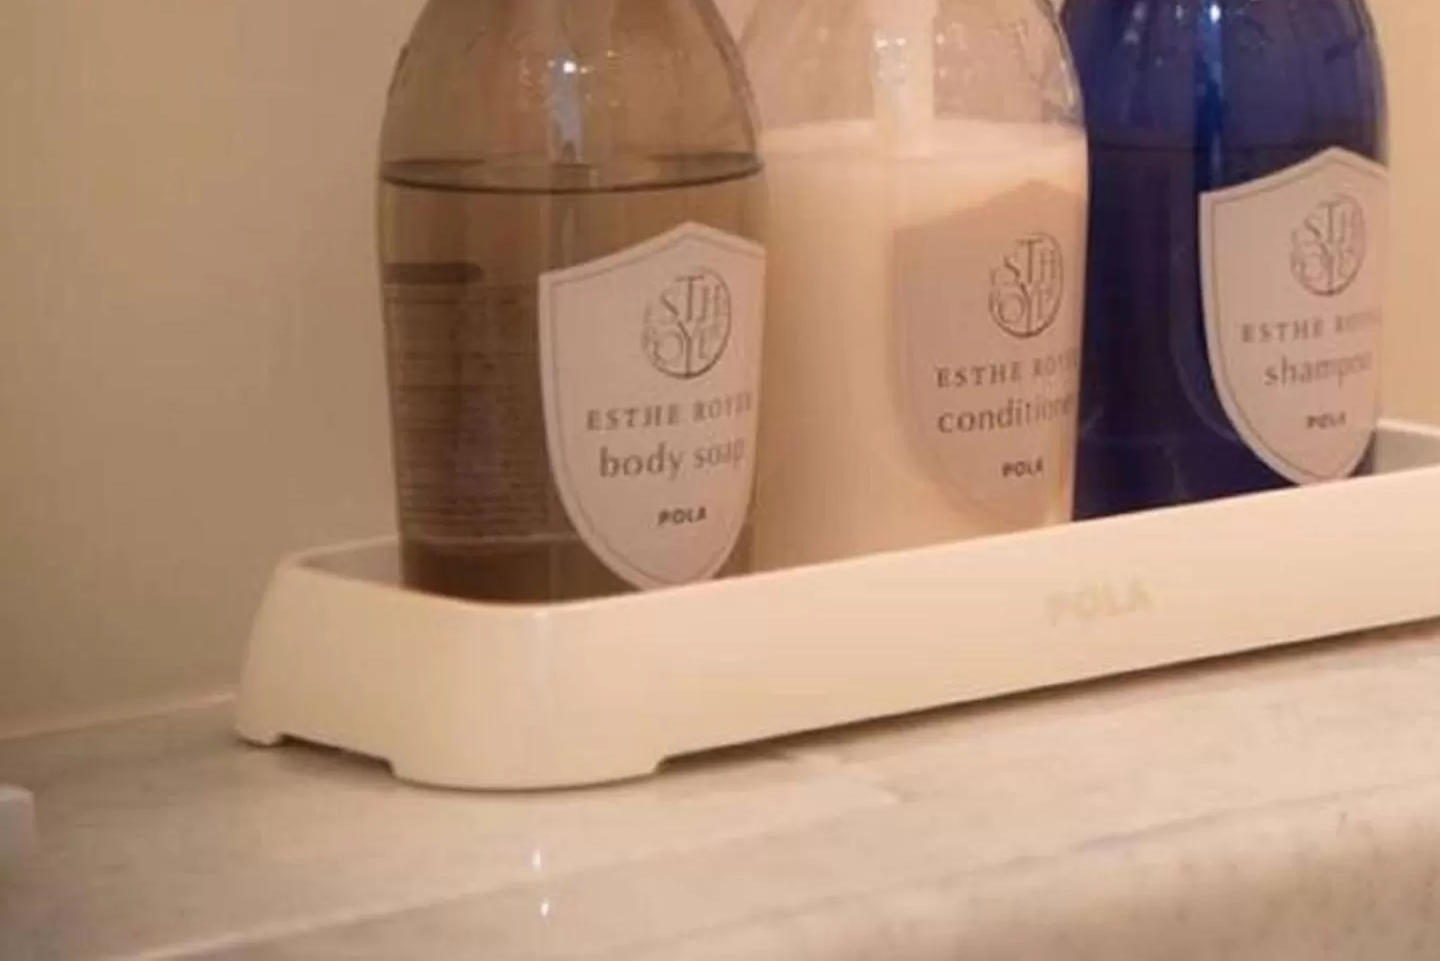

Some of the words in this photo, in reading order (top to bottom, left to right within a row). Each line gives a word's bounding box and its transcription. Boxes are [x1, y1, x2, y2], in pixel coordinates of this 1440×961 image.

[1240, 316, 1324, 343] ESTHE
[935, 361, 1022, 388] ESTHE
[586, 402, 680, 432] ESTHE
[1306, 409, 1348, 430] POLA
[599, 441, 686, 481] body
[693, 437, 747, 470] soap
[1001, 455, 1044, 479] POLA
[656, 506, 708, 527] POLA
[1044, 574, 1154, 627] POLA
